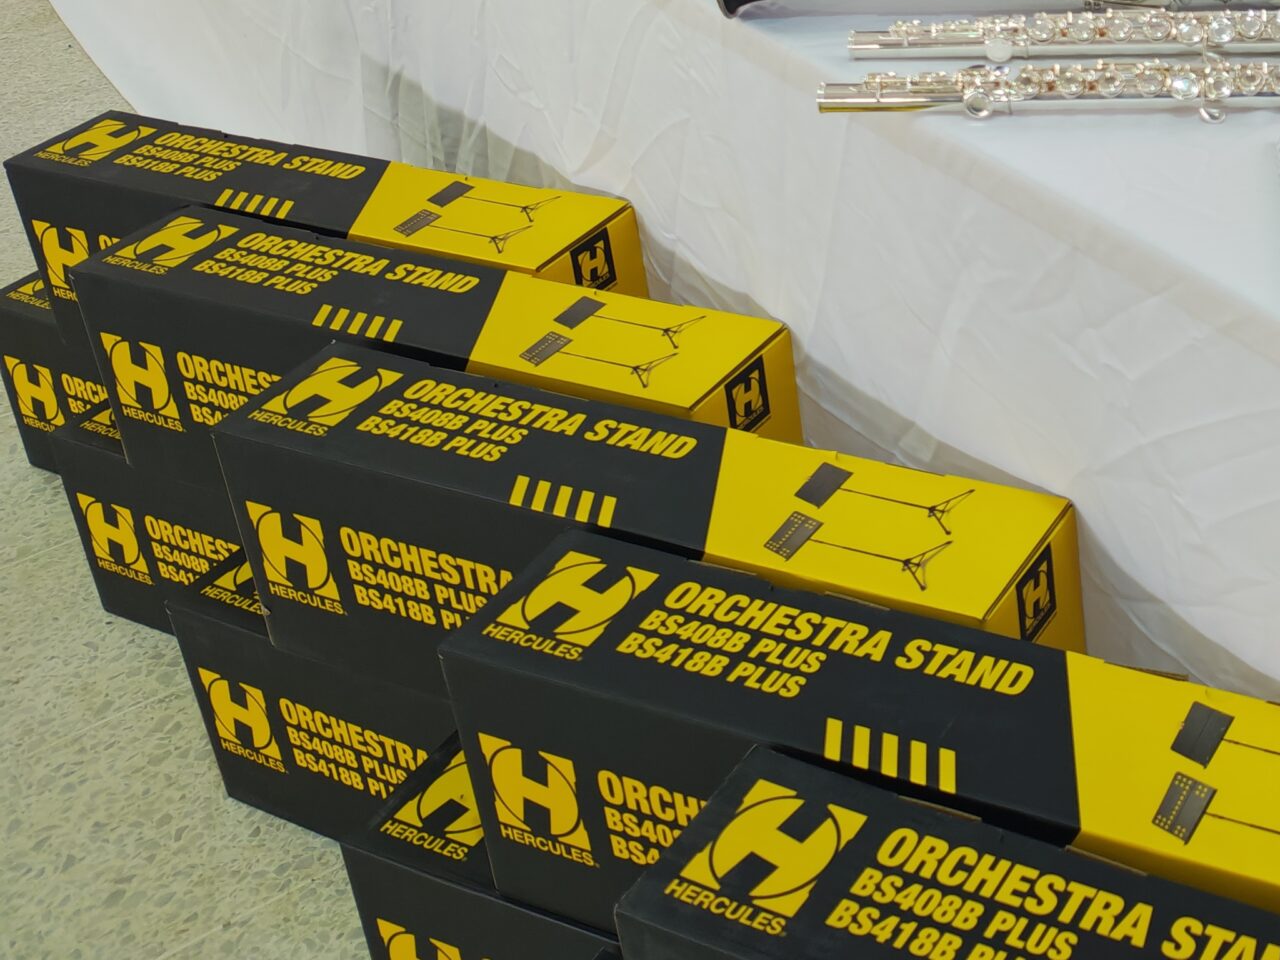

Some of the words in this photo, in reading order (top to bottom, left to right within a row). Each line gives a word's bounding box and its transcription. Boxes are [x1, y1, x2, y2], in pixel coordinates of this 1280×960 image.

[33, 151, 93, 168] HERCULES
[113, 154, 181, 176] BS418B
[175, 165, 223, 182] PLUS
[131, 145, 198, 165] BS408B
[195, 155, 243, 172] PLUS
[153, 132, 288, 167] ORCHESTRA
[281, 156, 366, 181] STAND
[102, 255, 168, 276] HERCULES
[193, 260, 267, 285] BS418B
[262, 276, 318, 295] PLUS
[214, 248, 289, 273] BS408B
[283, 263, 339, 283] PLUS
[236, 232, 390, 276] ORCHESTRA
[385, 263, 481, 294] STAND
[122, 405, 185, 432] HERCULES
[247, 409, 328, 437] HERCULES
[355, 414, 444, 450] BS418B
[440, 435, 508, 463] PLUS
[377, 399, 468, 434] BS408B
[462, 420, 529, 446] PLUS
[402, 379, 587, 437] ORCHESTRA
[583, 419, 698, 460] STAND
[97, 557, 154, 586] HERCULES
[347, 558, 430, 601] BS408B
[268, 582, 345, 615] HERCULES
[353, 583, 437, 626] BS418B
[481, 622, 584, 662] HERCULES
[638, 609, 750, 658] BS408B
[743, 638, 828, 675] PLUS
[662, 579, 895, 663] ORCHESTRA
[892, 638, 1036, 697] STAND
[615, 632, 727, 680] BS418B
[725, 660, 808, 701] PLUS
[219, 738, 286, 774] HERCULES
[285, 725, 359, 769] BS408B
[292, 747, 365, 790] BS418B
[379, 820, 470, 862] HERCULES
[500, 824, 597, 867] HERCULES
[663, 878, 788, 937] HERCULES
[874, 826, 1155, 949] ORCHESTRA
[824, 899, 964, 960] BS418B
[849, 867, 985, 932] BS408B
[982, 910, 1079, 960] PLUS
